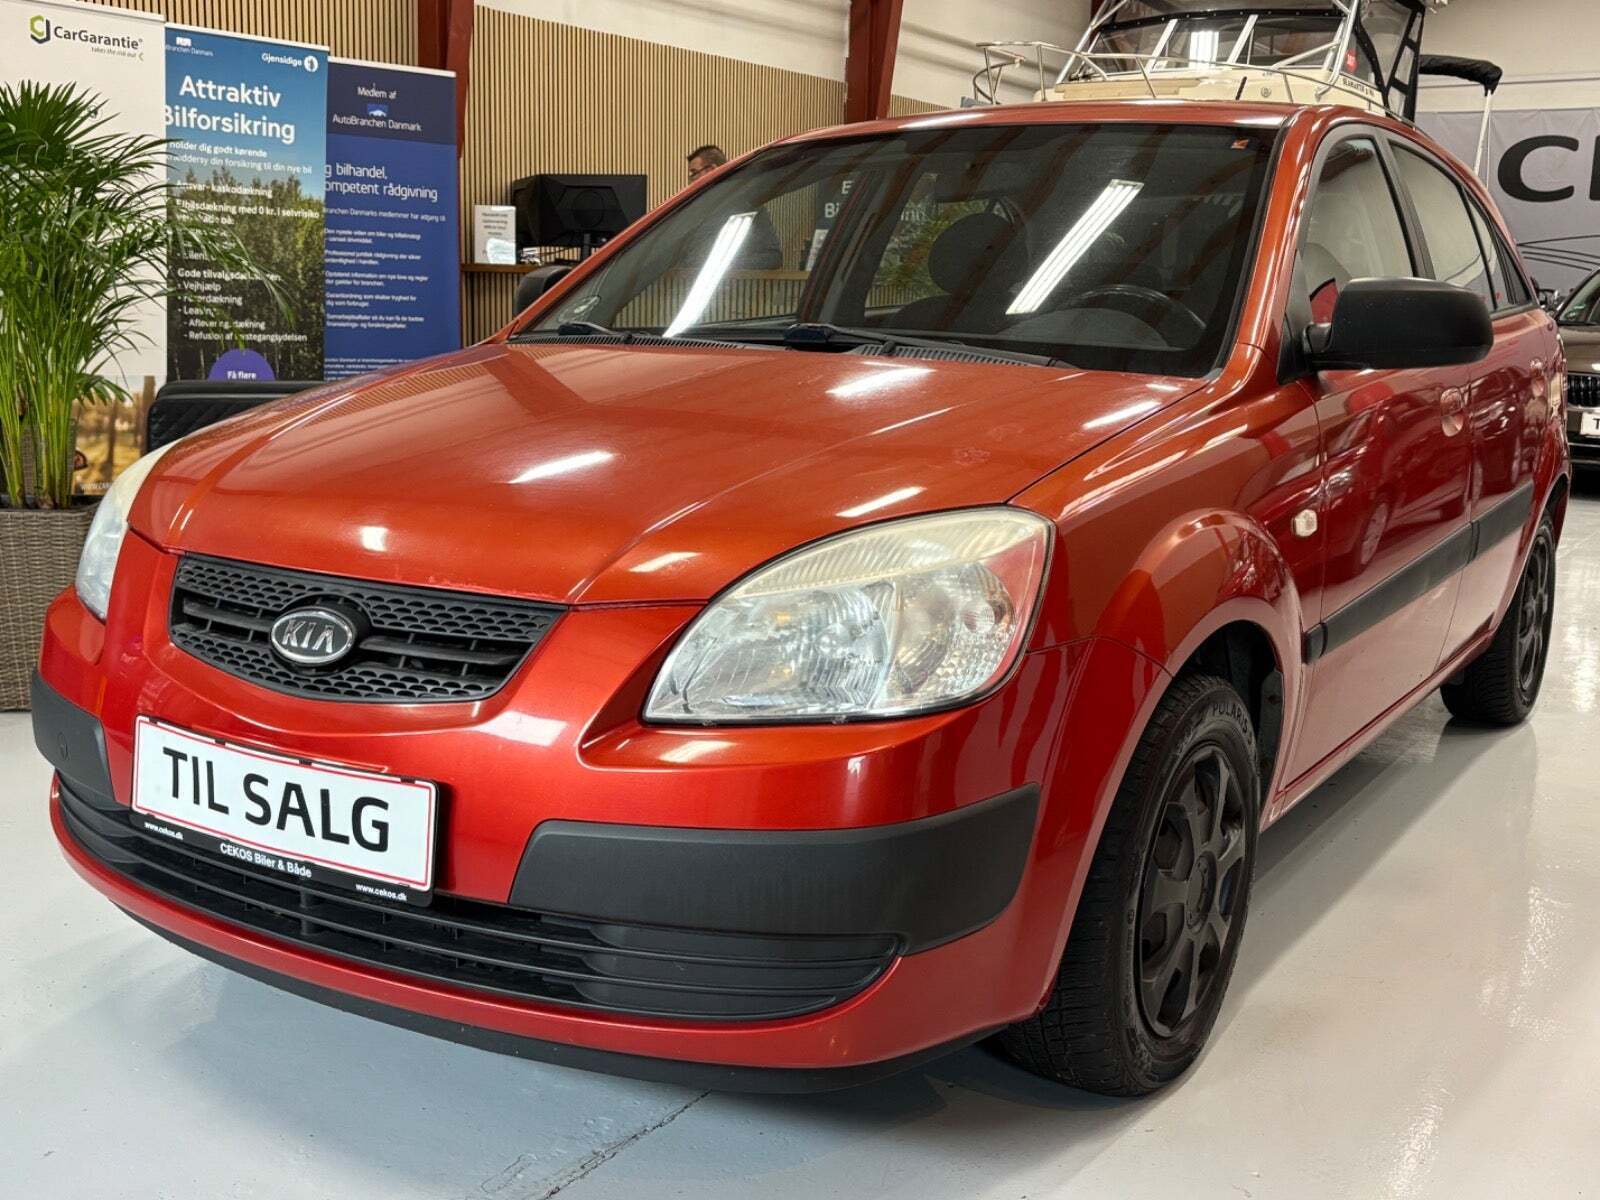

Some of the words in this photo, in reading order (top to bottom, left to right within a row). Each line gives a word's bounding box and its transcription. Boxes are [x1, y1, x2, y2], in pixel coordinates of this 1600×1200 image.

[54, 26, 140, 49] CarGarantie
[261, 52, 303, 67] Gjensidige
[178, 75, 281, 107] Attraktiv
[357, 86, 387, 98] Medlem
[388, 90, 397, 99] af
[164, 104, 296, 145] Bilforsikring
[332, 113, 387, 128] AutoBranchen
[388, 119, 422, 131] Danmark
[198, 142, 212, 154] dig
[213, 145, 233, 155] godt
[234, 147, 267, 158] kørende
[209, 156, 224, 166] din
[224, 158, 262, 172] forsikring
[263, 161, 271, 170] til
[272, 163, 286, 171] din
[287, 165, 301, 174] nye
[302, 165, 313, 174] bil
[1497, 134, 1600, 203] C
[383, 182, 438, 203] rådgivning
[238, 205, 258, 215] med
[258, 206, 265, 215] 0
[281, 207, 320, 221] selvrisiko
[177, 268, 202, 278] Gode
[183, 281, 222, 292] Vejhjælp
[227, 371, 235, 380] Få
[238, 371, 257, 380] flere
[281, 619, 335, 654] KIA
[162, 746, 230, 815] TIL
[242, 772, 390, 853] SALG
[144, 821, 184, 840] www.cekos.dk
[220, 843, 253, 861] CEKOS
[255, 853, 276, 868] Biler
[278, 859, 286, 871] &
[287, 859, 313, 878] Både
[356, 882, 408, 902] www.cekos.dk
